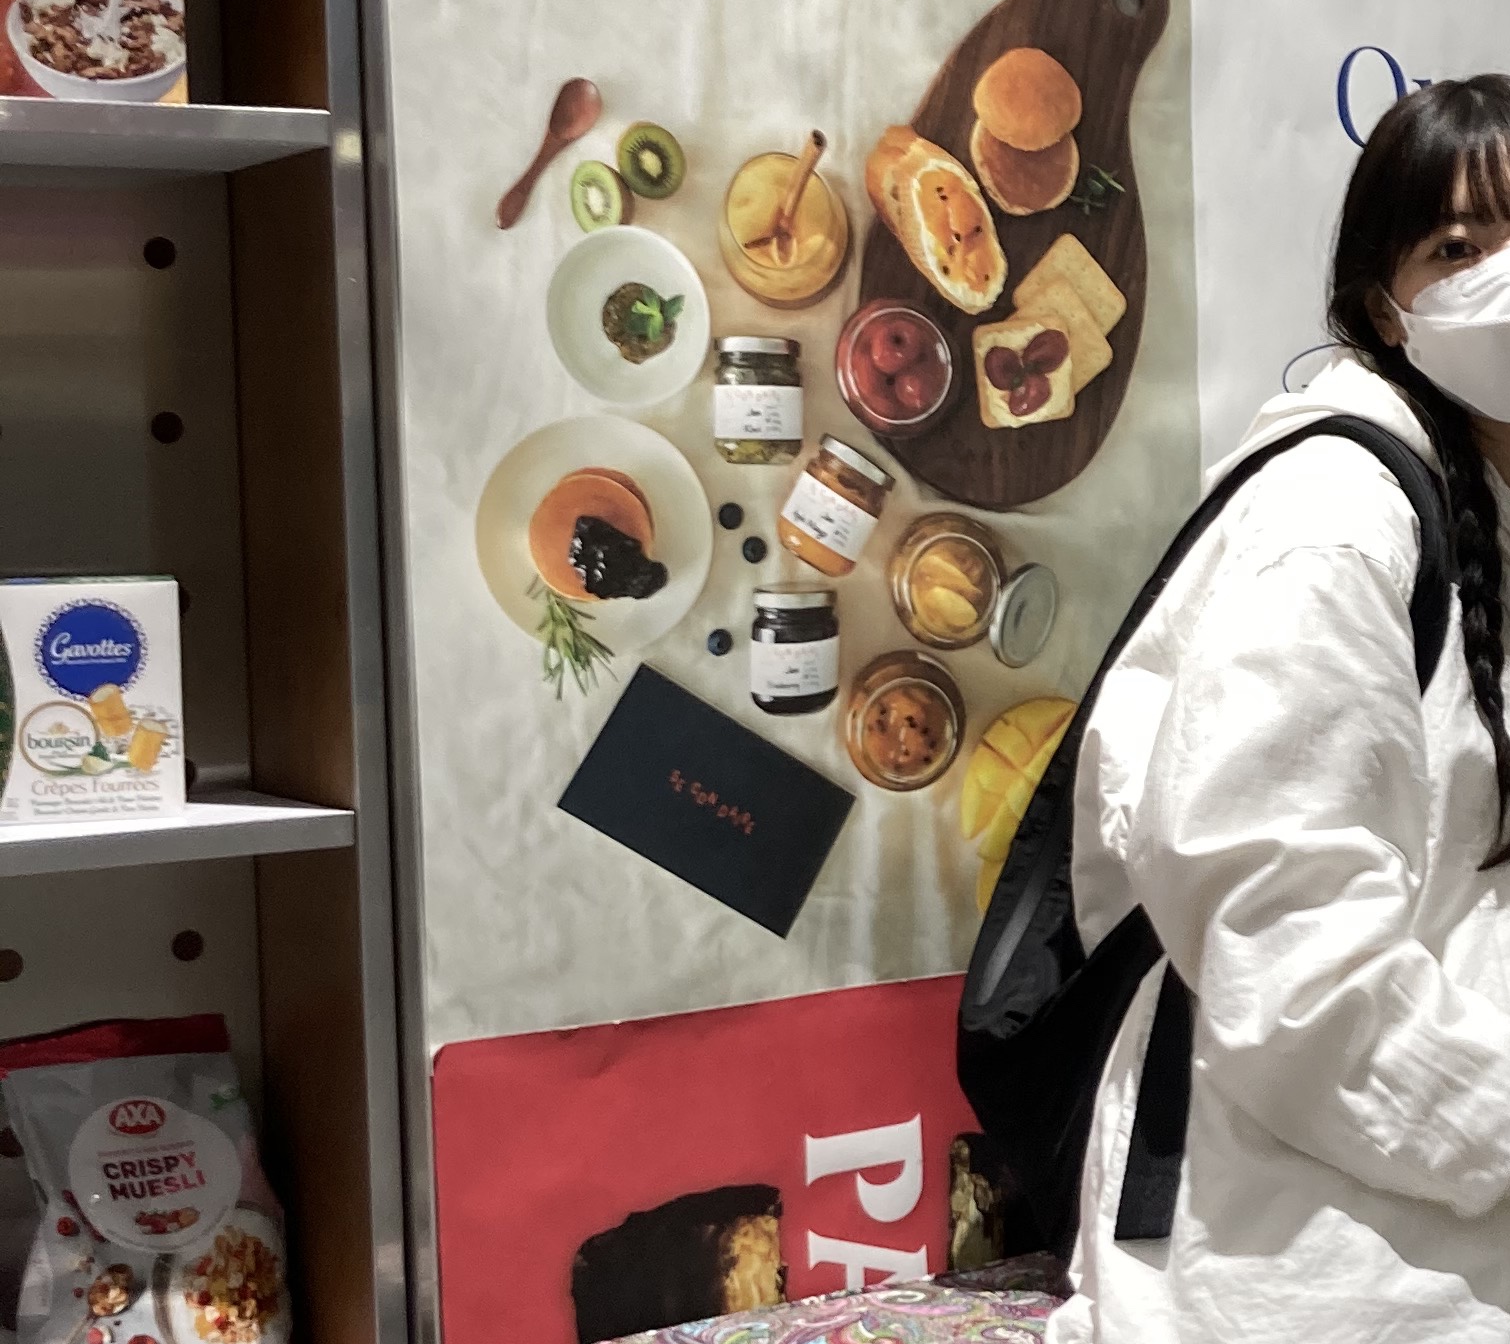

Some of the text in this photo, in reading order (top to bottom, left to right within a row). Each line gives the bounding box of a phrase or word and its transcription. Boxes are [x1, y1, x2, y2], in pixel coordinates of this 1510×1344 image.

[50, 631, 132, 667] Gavottes
[114, 1104, 165, 1129] AXA
[102, 1150, 197, 1182] CRISPY
[108, 1169, 207, 1203] MUESLI
